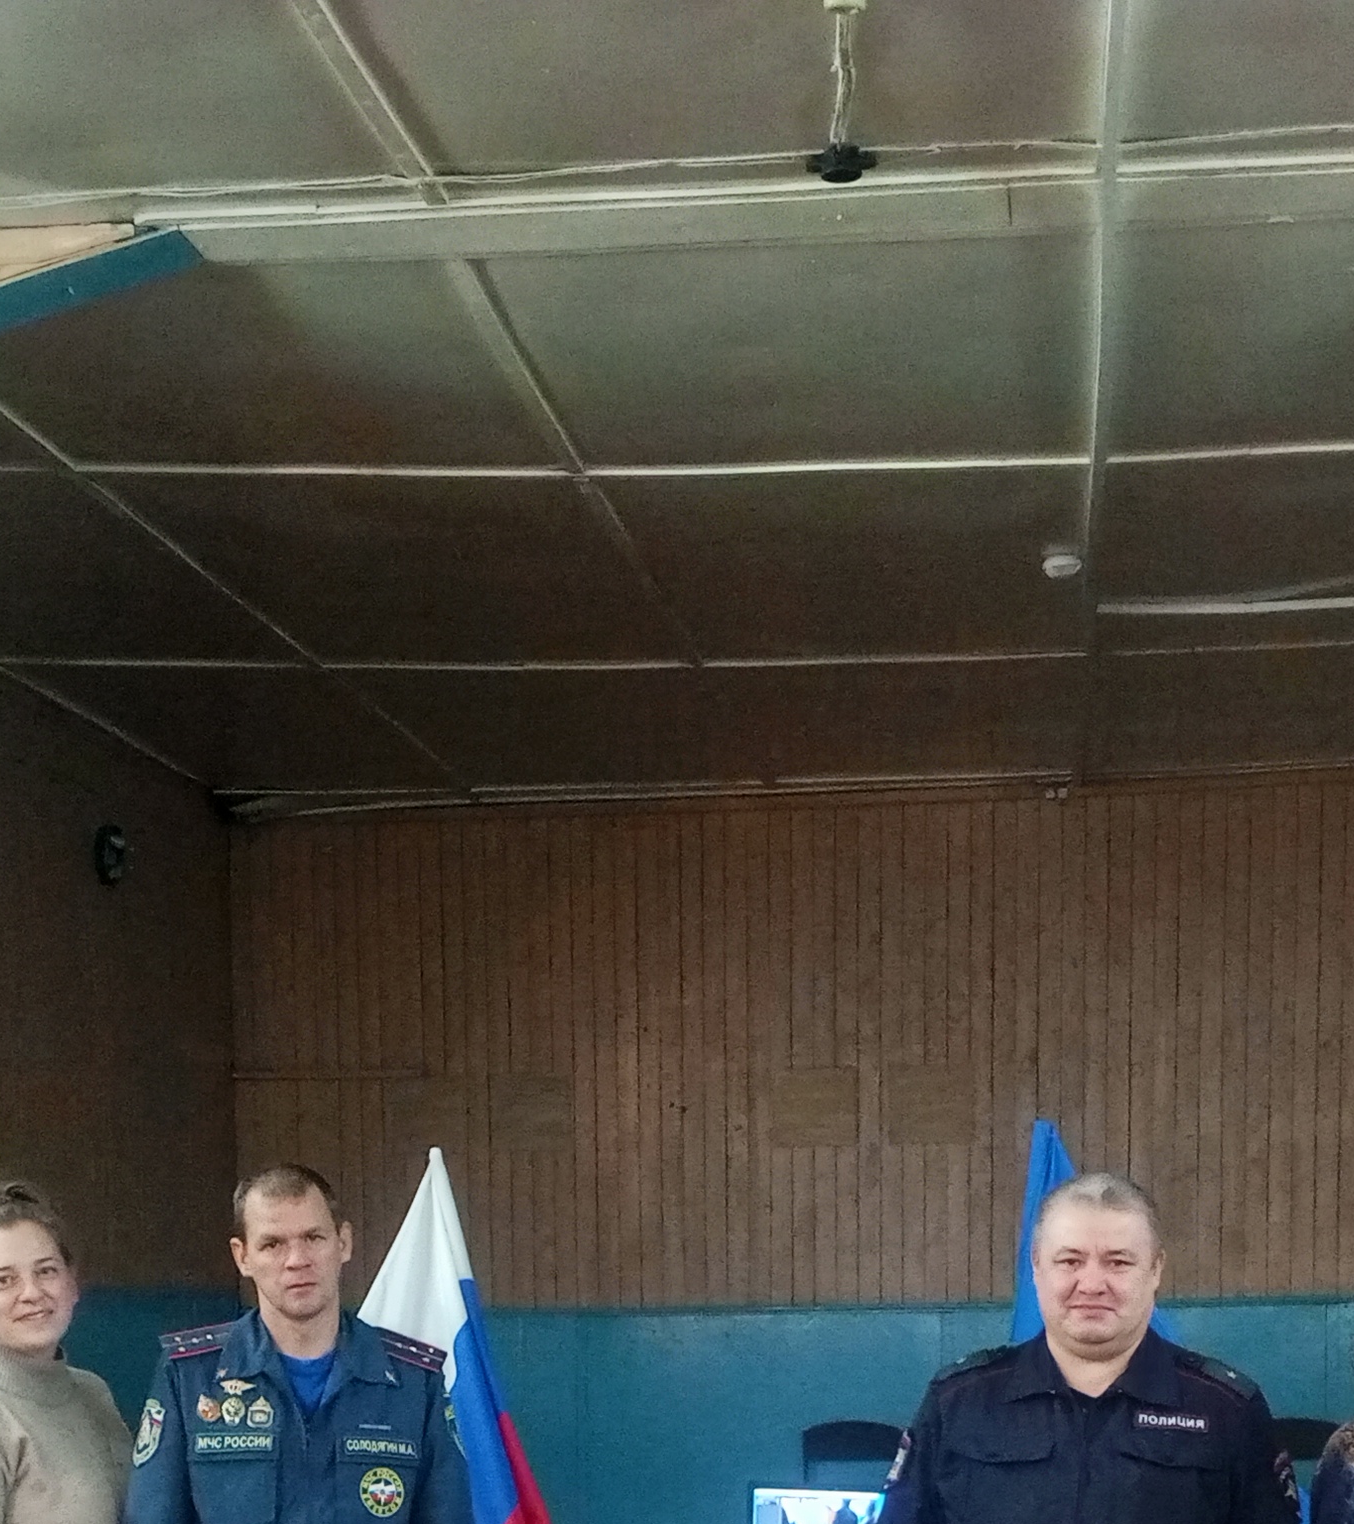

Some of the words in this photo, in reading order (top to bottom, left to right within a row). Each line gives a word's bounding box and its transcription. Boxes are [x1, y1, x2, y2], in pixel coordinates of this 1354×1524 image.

[1138, 1414, 1205, 1429] ПОЛИЦИЯ
[198, 1436, 223, 1449] МЧС
[224, 1435, 271, 1448] РОССИИ
[346, 1439, 398, 1453] СОЛОДЯГИН
